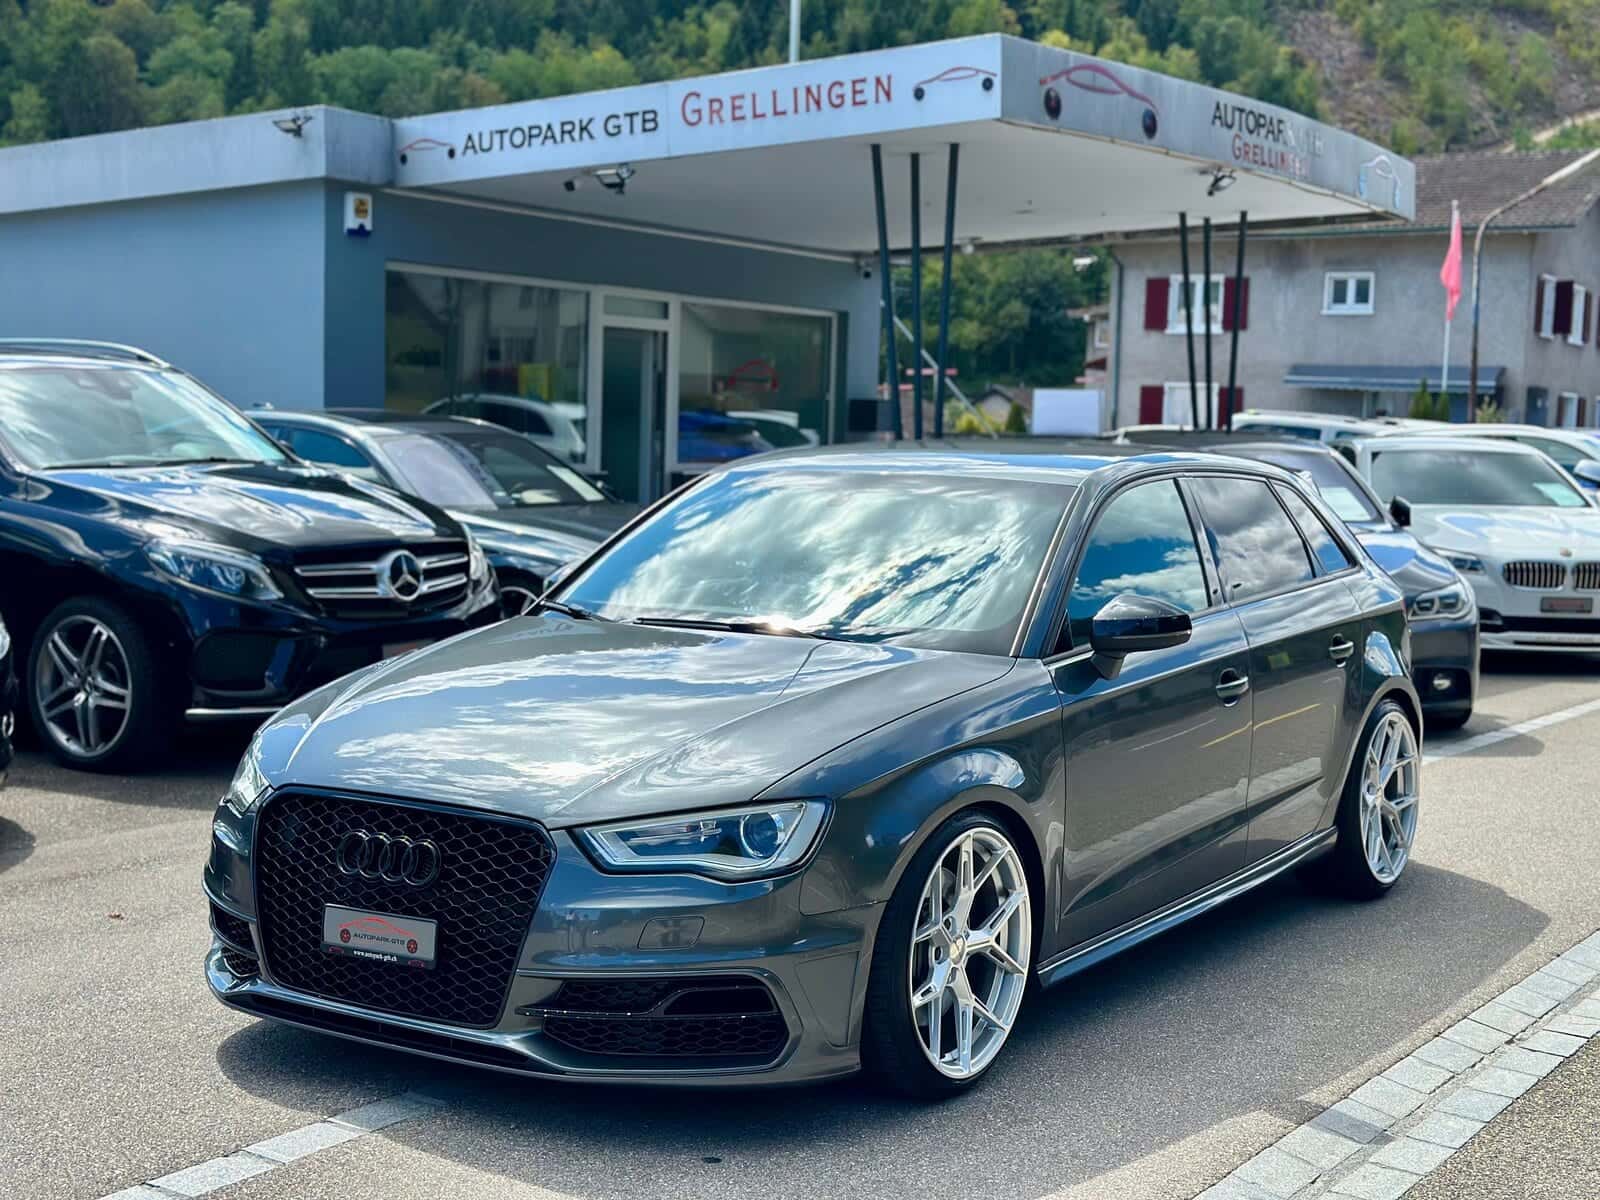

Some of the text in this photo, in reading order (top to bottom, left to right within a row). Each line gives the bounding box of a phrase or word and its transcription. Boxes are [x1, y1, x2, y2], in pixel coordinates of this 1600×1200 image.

[463, 75, 893, 156] AUTOPARK GTB GRELLINGEN
[1211, 101, 1297, 147] AUTOPAR
[1232, 134, 1310, 175] GRELLIN
